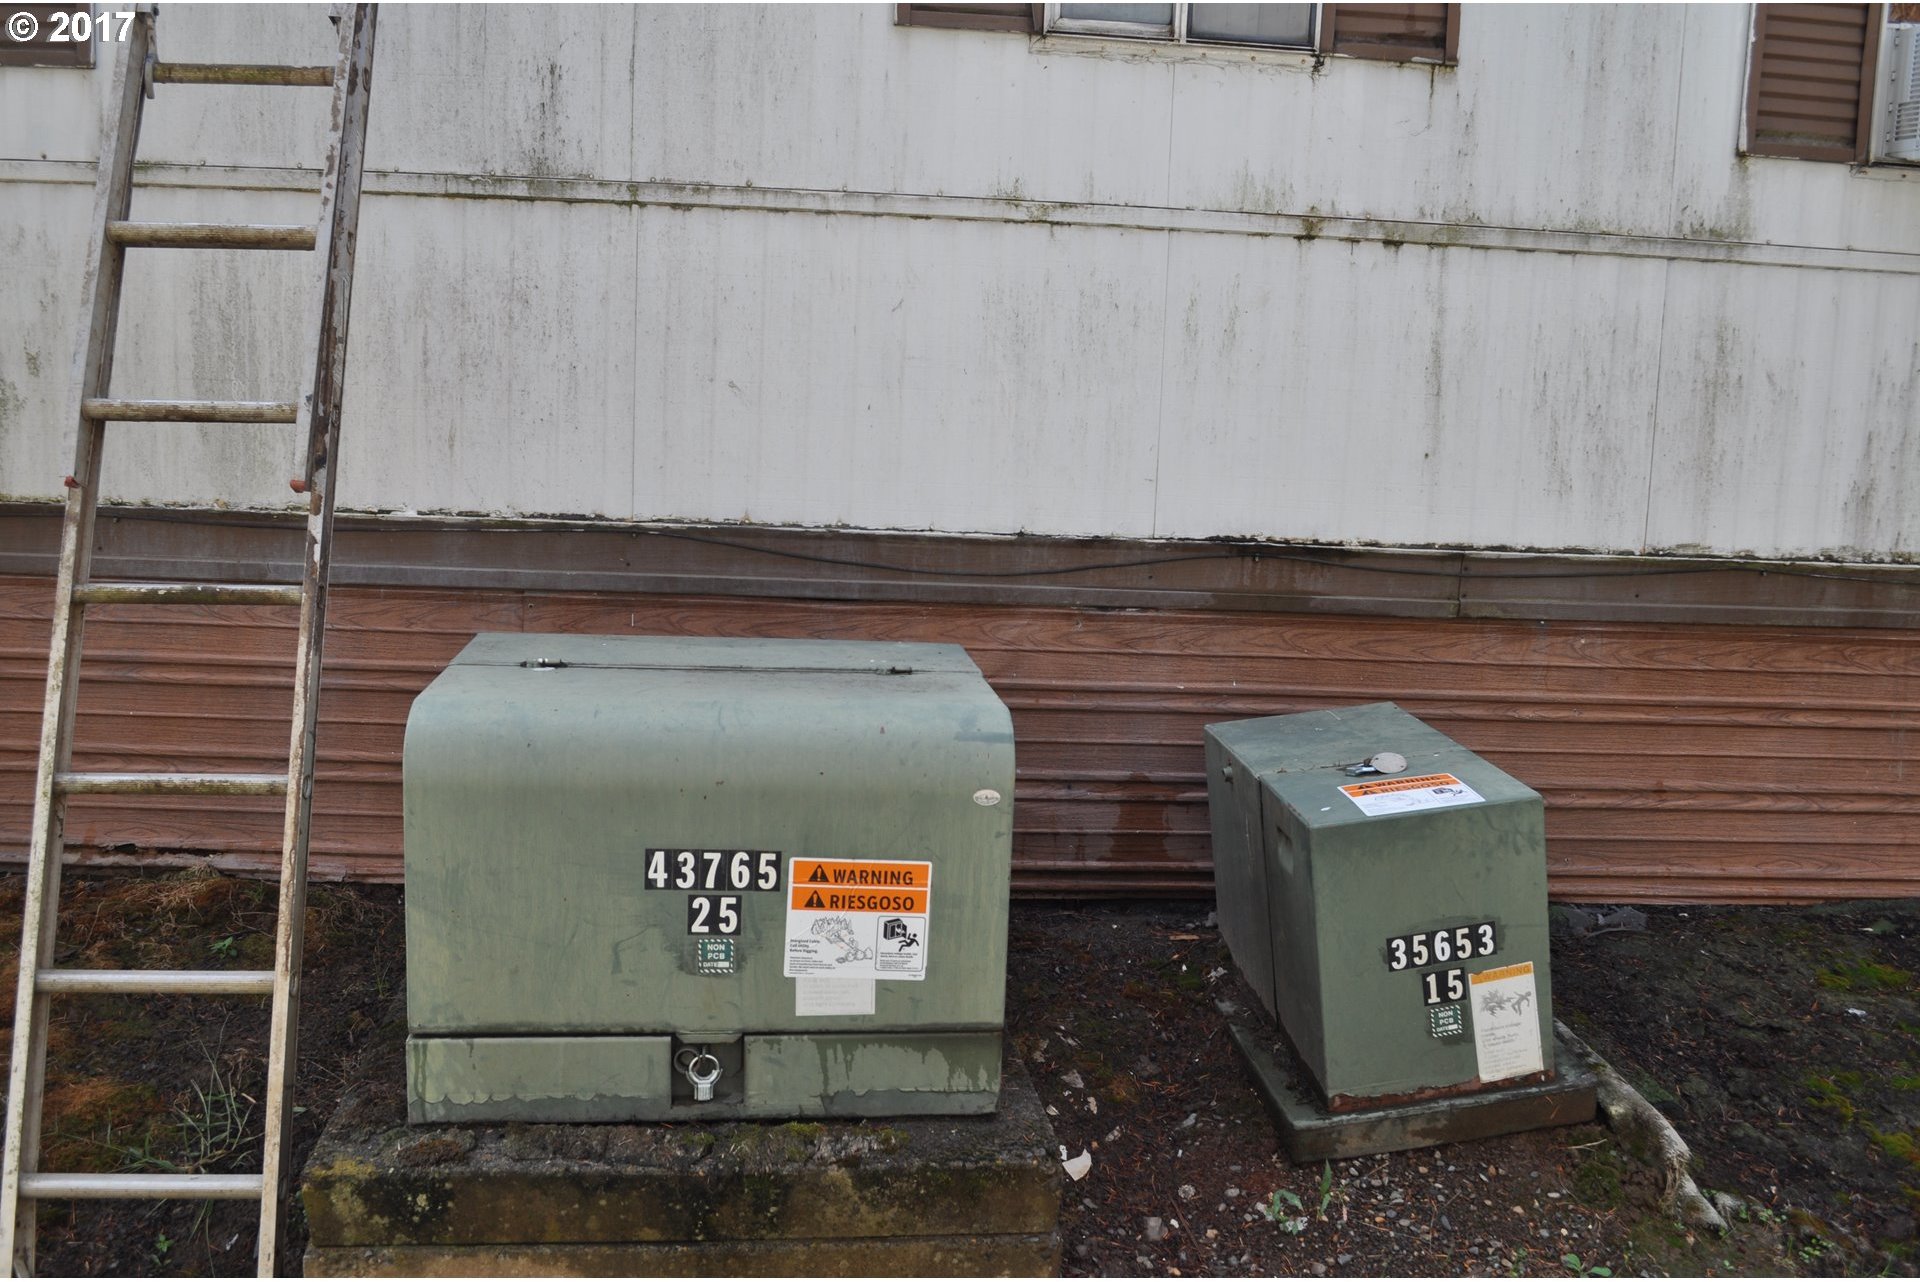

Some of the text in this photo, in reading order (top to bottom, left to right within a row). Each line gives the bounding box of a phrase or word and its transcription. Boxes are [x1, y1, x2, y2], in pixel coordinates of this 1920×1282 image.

[1374, 776, 1441, 786] WARNING
[1380, 781, 1449, 793] RIESGOSO
[647, 851, 778, 890] 43765
[833, 868, 914, 886] WARNING
[829, 894, 915, 911] RIESGOSO
[691, 896, 738, 934] 25
[707, 943, 726, 951] NON
[1391, 924, 1495, 970] 35653
[707, 952, 726, 960] PCB
[1484, 965, 1530, 981] WARNING
[1426, 969, 1464, 1004] 15
[1438, 1010, 1453, 1018] NON
